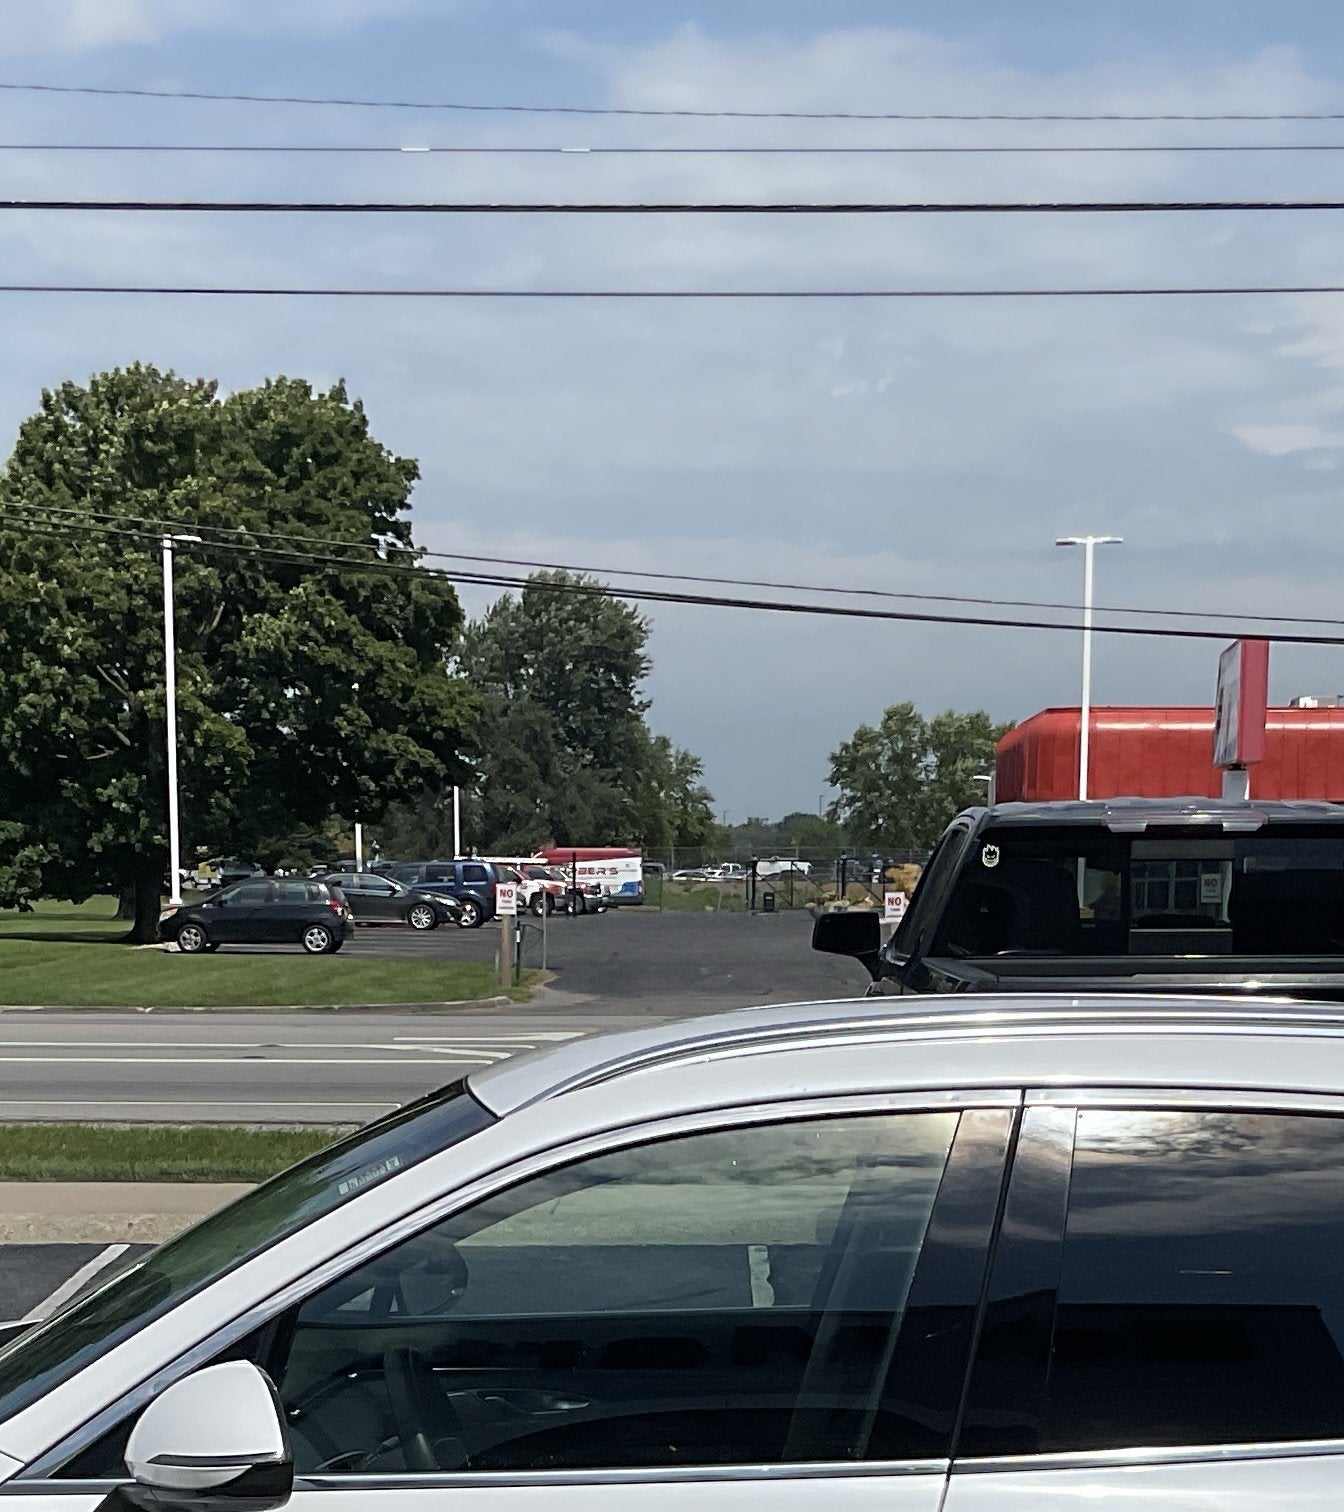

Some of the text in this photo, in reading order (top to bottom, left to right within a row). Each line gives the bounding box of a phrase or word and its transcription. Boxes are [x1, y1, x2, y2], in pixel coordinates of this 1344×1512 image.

[577, 867, 619, 876] BER'S
[500, 889, 514, 899] NO
[888, 897, 902, 907] NO
